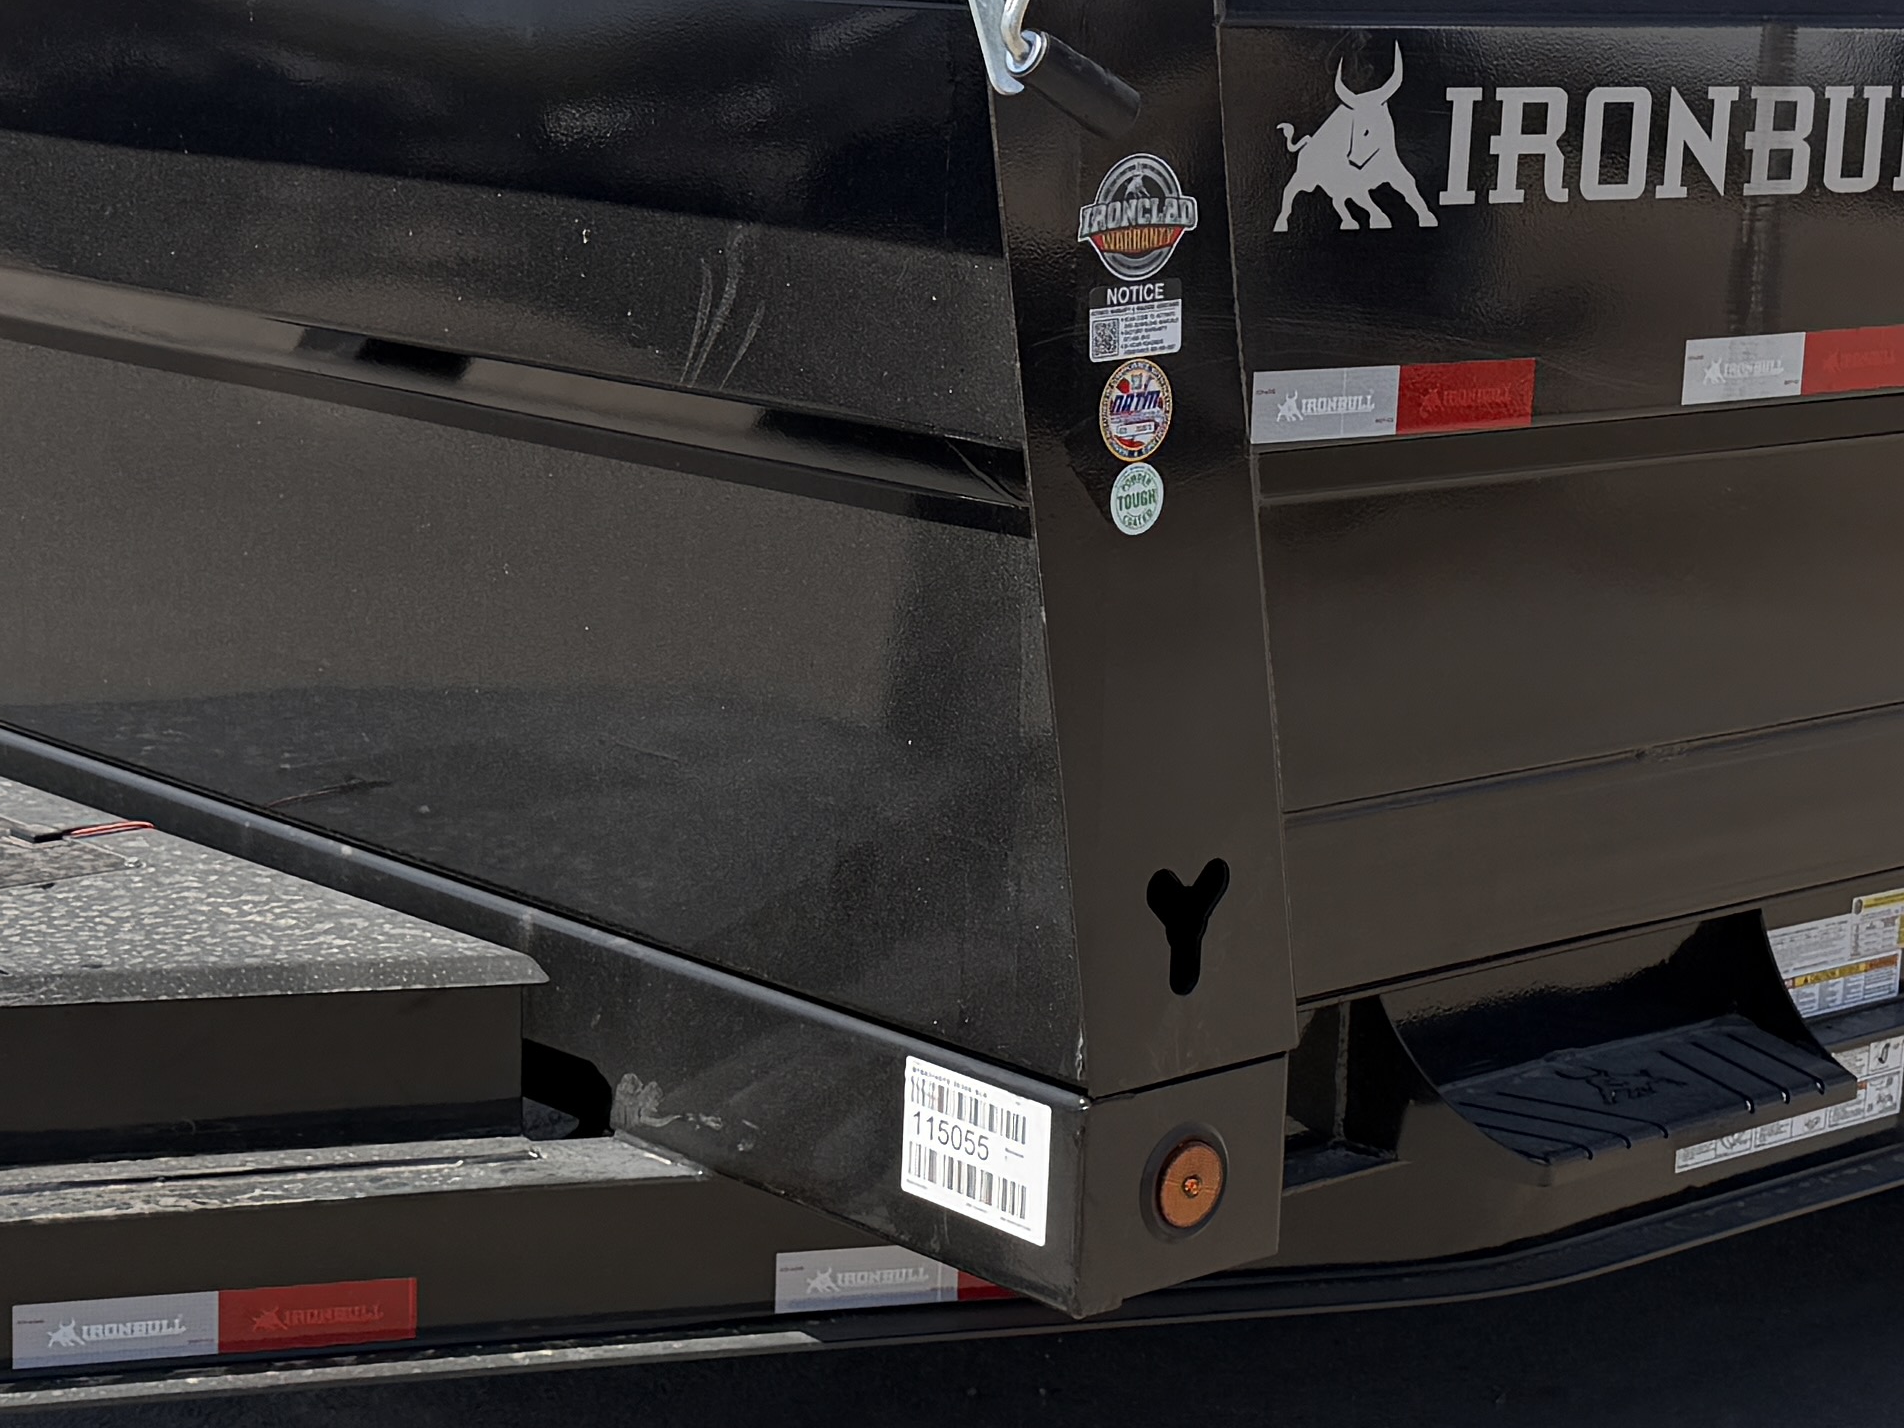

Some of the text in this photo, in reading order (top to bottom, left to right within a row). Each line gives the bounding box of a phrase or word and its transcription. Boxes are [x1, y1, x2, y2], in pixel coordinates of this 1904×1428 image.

[1081, 197, 1196, 236] IRONCLAD
[1102, 227, 1174, 250] WARRANTY
[1107, 283, 1165, 305] NOTICE
[1301, 393, 1375, 414] IRONBULL
[1117, 488, 1156, 511] TOUGH
[913, 1110, 990, 1161] 115055
[837, 1267, 929, 1287] IRONBULL
[81, 1303, 385, 1341] IRONBULL IRONBULL
